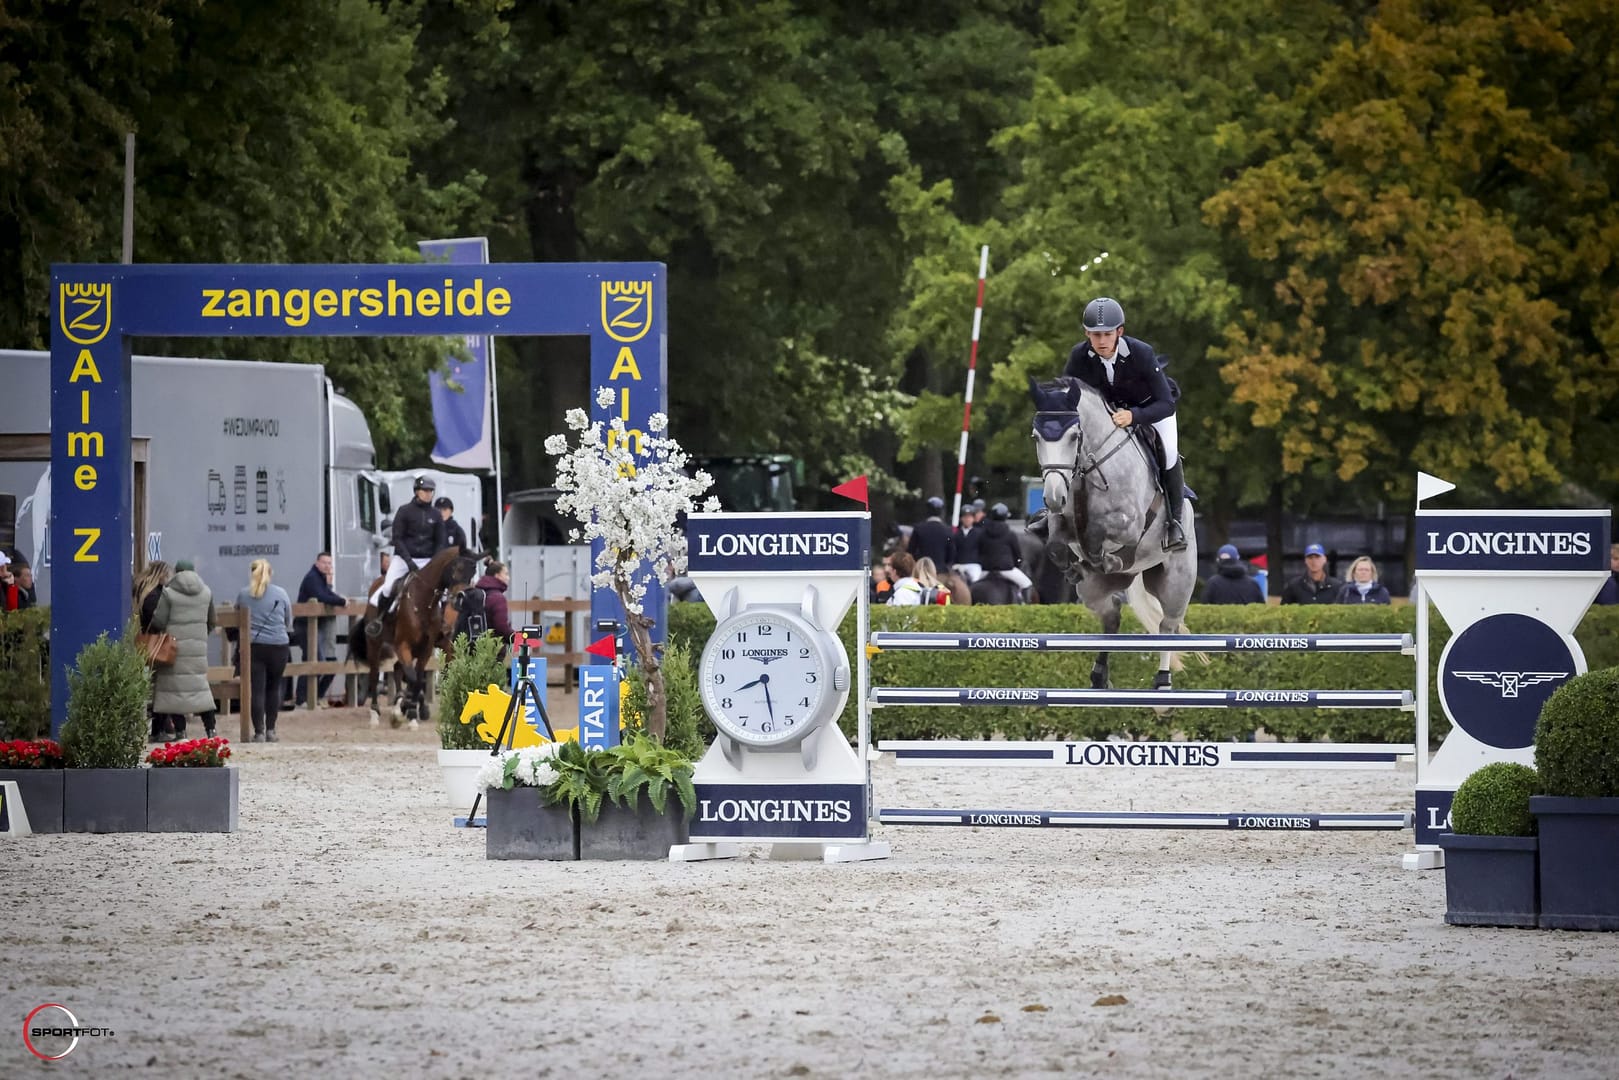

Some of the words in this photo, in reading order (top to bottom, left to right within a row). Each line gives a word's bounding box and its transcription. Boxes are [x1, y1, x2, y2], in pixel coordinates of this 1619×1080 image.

[201, 279, 512, 327] zangersheide
[73, 528, 101, 562] Z
[699, 533, 849, 556] LONGINES
[1427, 532, 1592, 555] LONGINES
[758, 625, 772, 635] 12
[737, 632, 747, 642] 11
[968, 638, 1039, 648] LONGINES
[1235, 638, 1308, 649] LONGINES
[722, 649, 735, 660] 10
[742, 649, 788, 657] LONGINES
[800, 648, 810, 659] 2
[714, 674, 725, 684] 9
[805, 672, 817, 684] 3
[968, 690, 1039, 700] LONGINES
[1235, 691, 1309, 702] LONGINES
[721, 698, 733, 709] 8
[798, 697, 810, 708] 4
[739, 716, 749, 727] 7
[784, 716, 794, 726] 5
[761, 721, 772, 733] 6
[1066, 744, 1219, 767] LONGINES
[700, 800, 851, 822] LONGINES
[970, 814, 1041, 825] LONGINES
[1238, 817, 1311, 828] LONGINES
